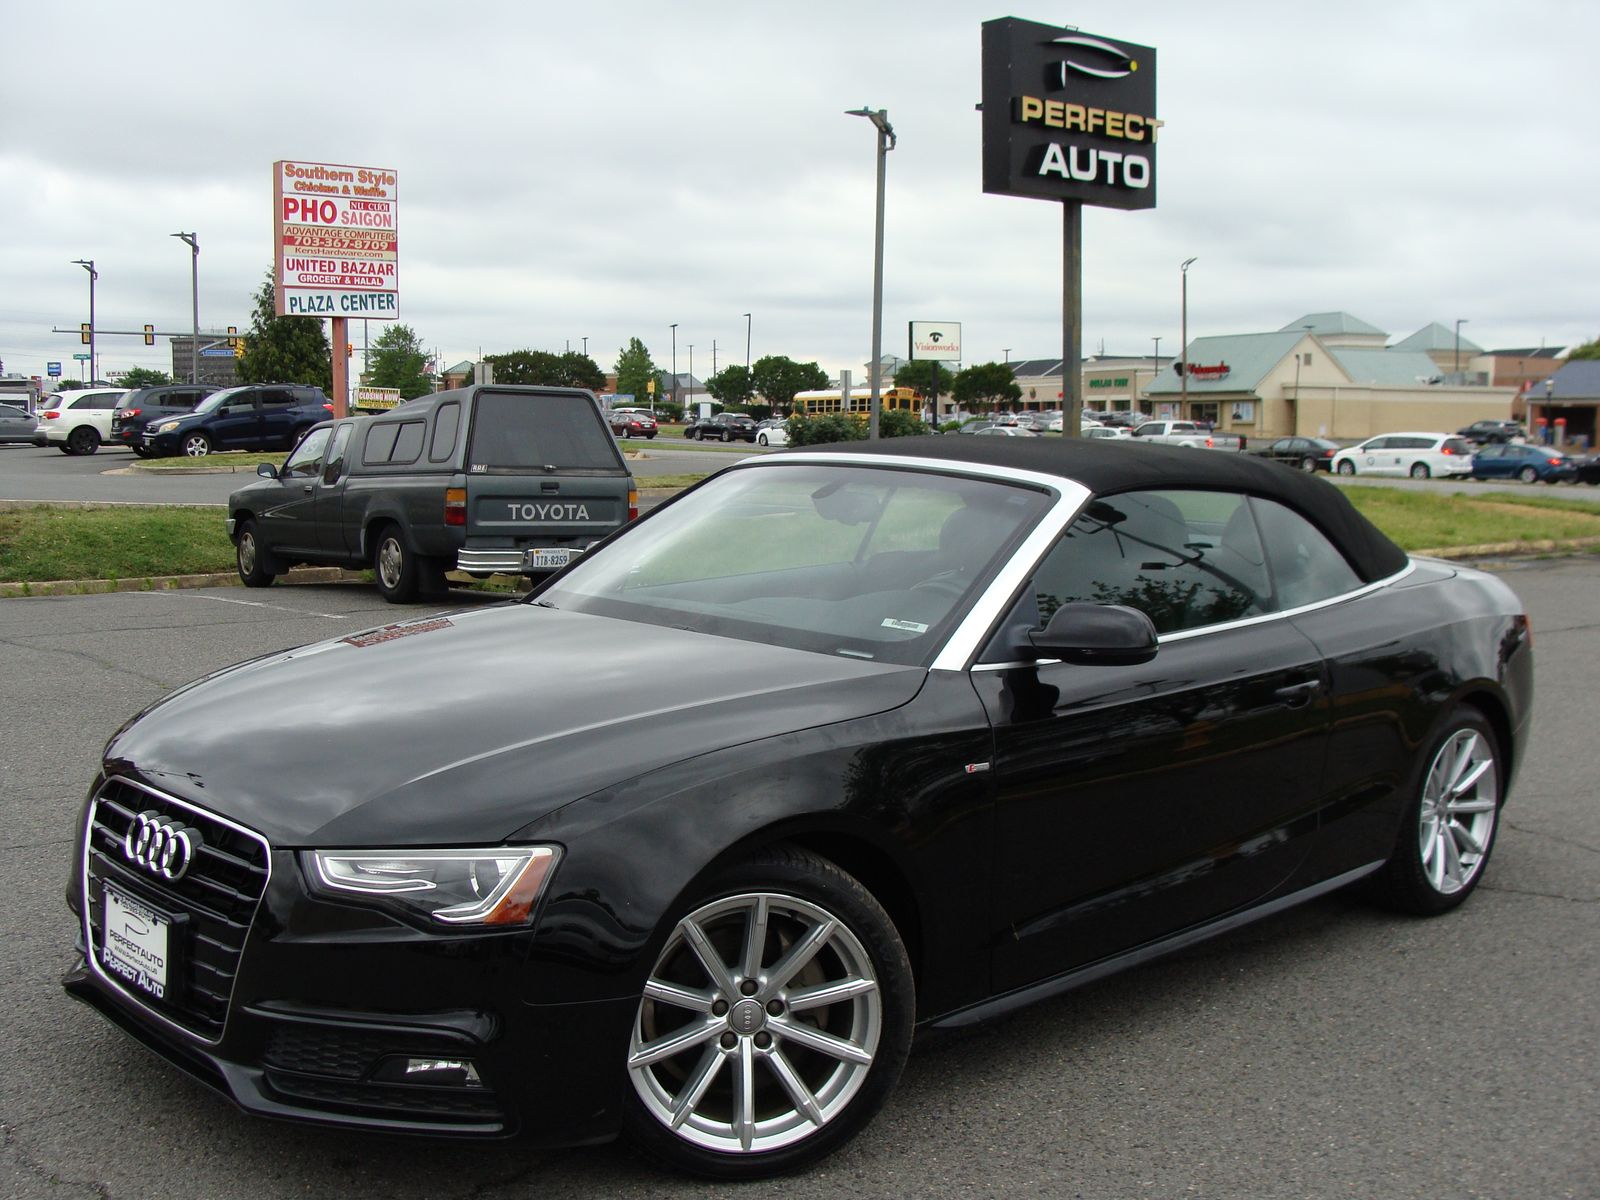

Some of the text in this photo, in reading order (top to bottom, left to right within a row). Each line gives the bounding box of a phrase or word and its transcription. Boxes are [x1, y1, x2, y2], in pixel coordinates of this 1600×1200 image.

[1021, 95, 1165, 143] PERFECT
[1038, 142, 1150, 189] AUTO
[284, 163, 396, 187] Southern Style
[293, 180, 387, 198] Chicken & Waffle
[283, 197, 338, 224] PHO
[341, 210, 392, 228] SAIGON
[285, 226, 396, 241] ADVANTAGE COMPUTERS
[294, 236, 389, 250] 703-367-8709
[294, 247, 384, 259] KensHardware.com
[286, 258, 394, 276] UNITED BAZAAR
[299, 274, 382, 286] GROCERY & HALAL
[289, 293, 395, 313] PLAZA CENTER
[915, 341, 959, 352] Visionworks
[358, 391, 383, 401] CLOSING
[507, 503, 590, 520] TOYOTA
[103, 947, 164, 999] PERFECT AUTO
